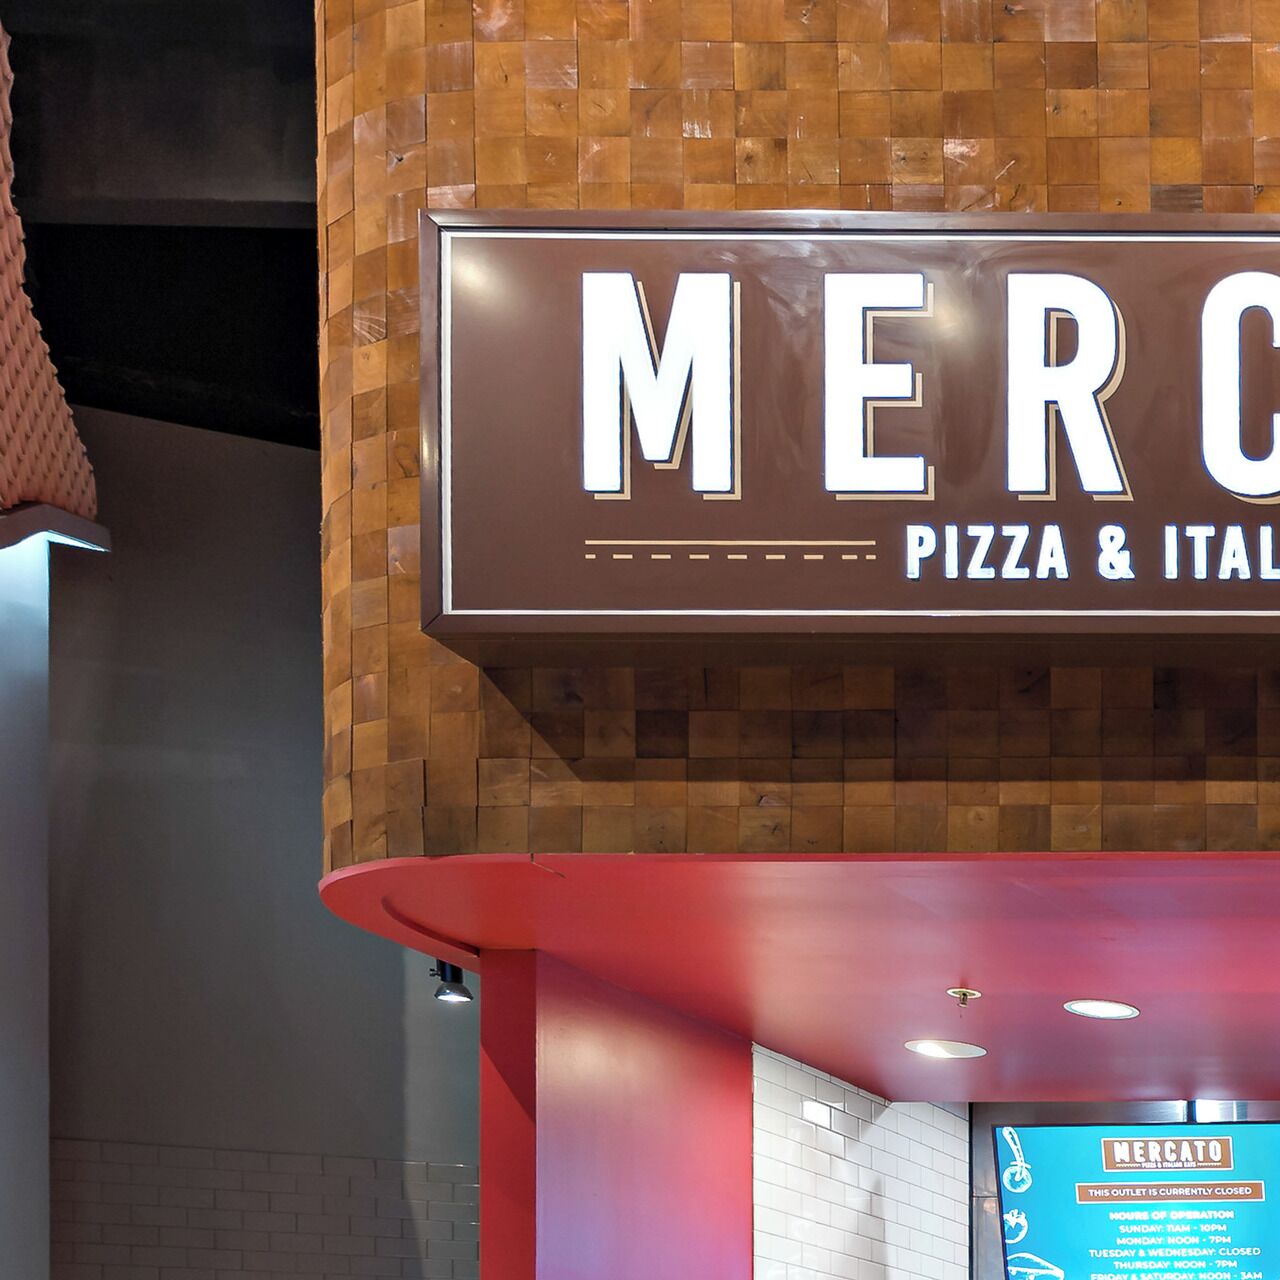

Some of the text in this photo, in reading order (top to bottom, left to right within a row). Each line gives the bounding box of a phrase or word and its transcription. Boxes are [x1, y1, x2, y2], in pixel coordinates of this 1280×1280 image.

[905, 524, 1070, 581] PIZZA
[1098, 524, 1136, 581] &
[1113, 1140, 1222, 1163] MERCATO
[1111, 1188, 1147, 1196] OUTLET
[1148, 1188, 1158, 1196] IS
[1159, 1187, 1212, 1196] CURRENTLY
[1214, 1187, 1252, 1195] CLOSED
[1109, 1210, 1234, 1220] HOURS OF OPERATION
[1166, 1224, 1190, 1232] 11AM
[1200, 1224, 1227, 1232] 10PM
[1168, 1236, 1200, 1244] NOON
[1089, 1249, 1136, 1258] TUESDAY
[1219, 1248, 1261, 1256] CLOSED
[1174, 1260, 1206, 1268] NOON
[1216, 1260, 1238, 1268] 7PM
[1199, 1272, 1231, 1280] NOON
[1240, 1272, 1263, 1280] 3AM
